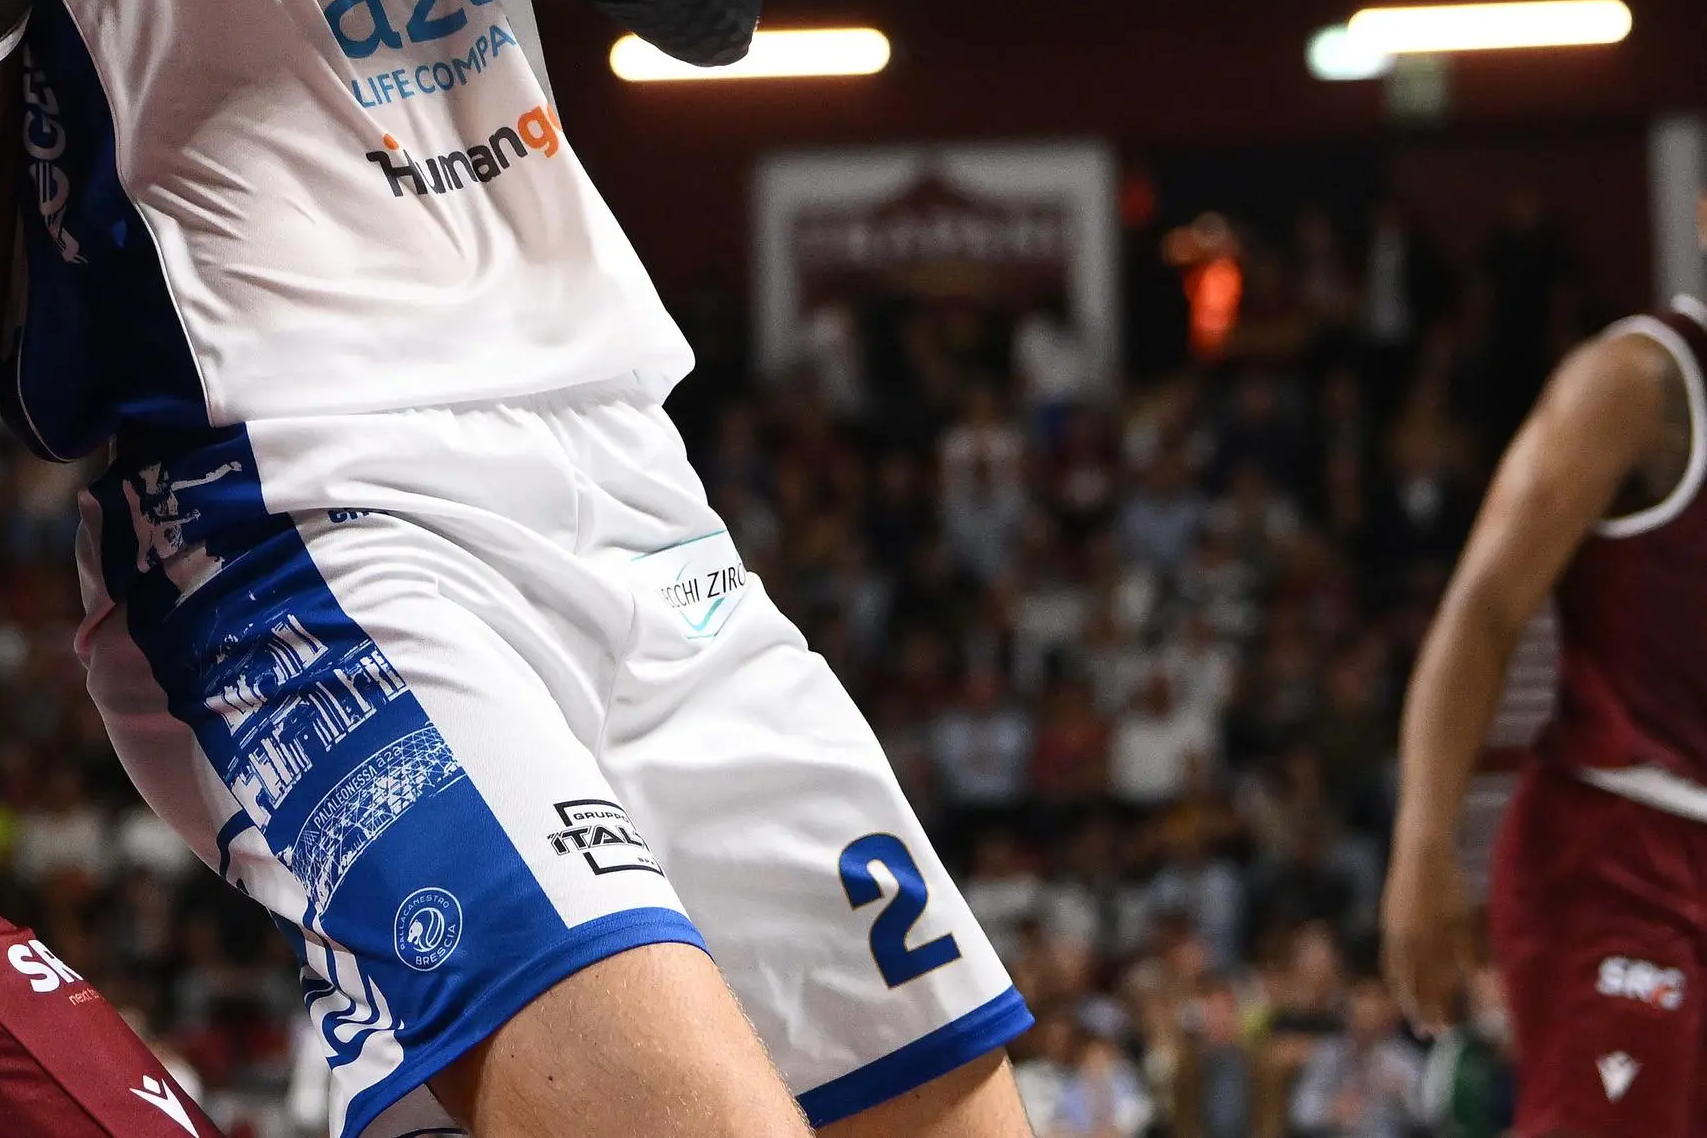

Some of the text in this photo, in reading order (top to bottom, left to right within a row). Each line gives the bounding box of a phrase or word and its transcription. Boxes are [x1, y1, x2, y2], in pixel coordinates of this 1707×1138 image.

[352, 68, 415, 109] LIFE
[838, 832, 963, 990] 2
[415, 924, 456, 965] BRESCIA
